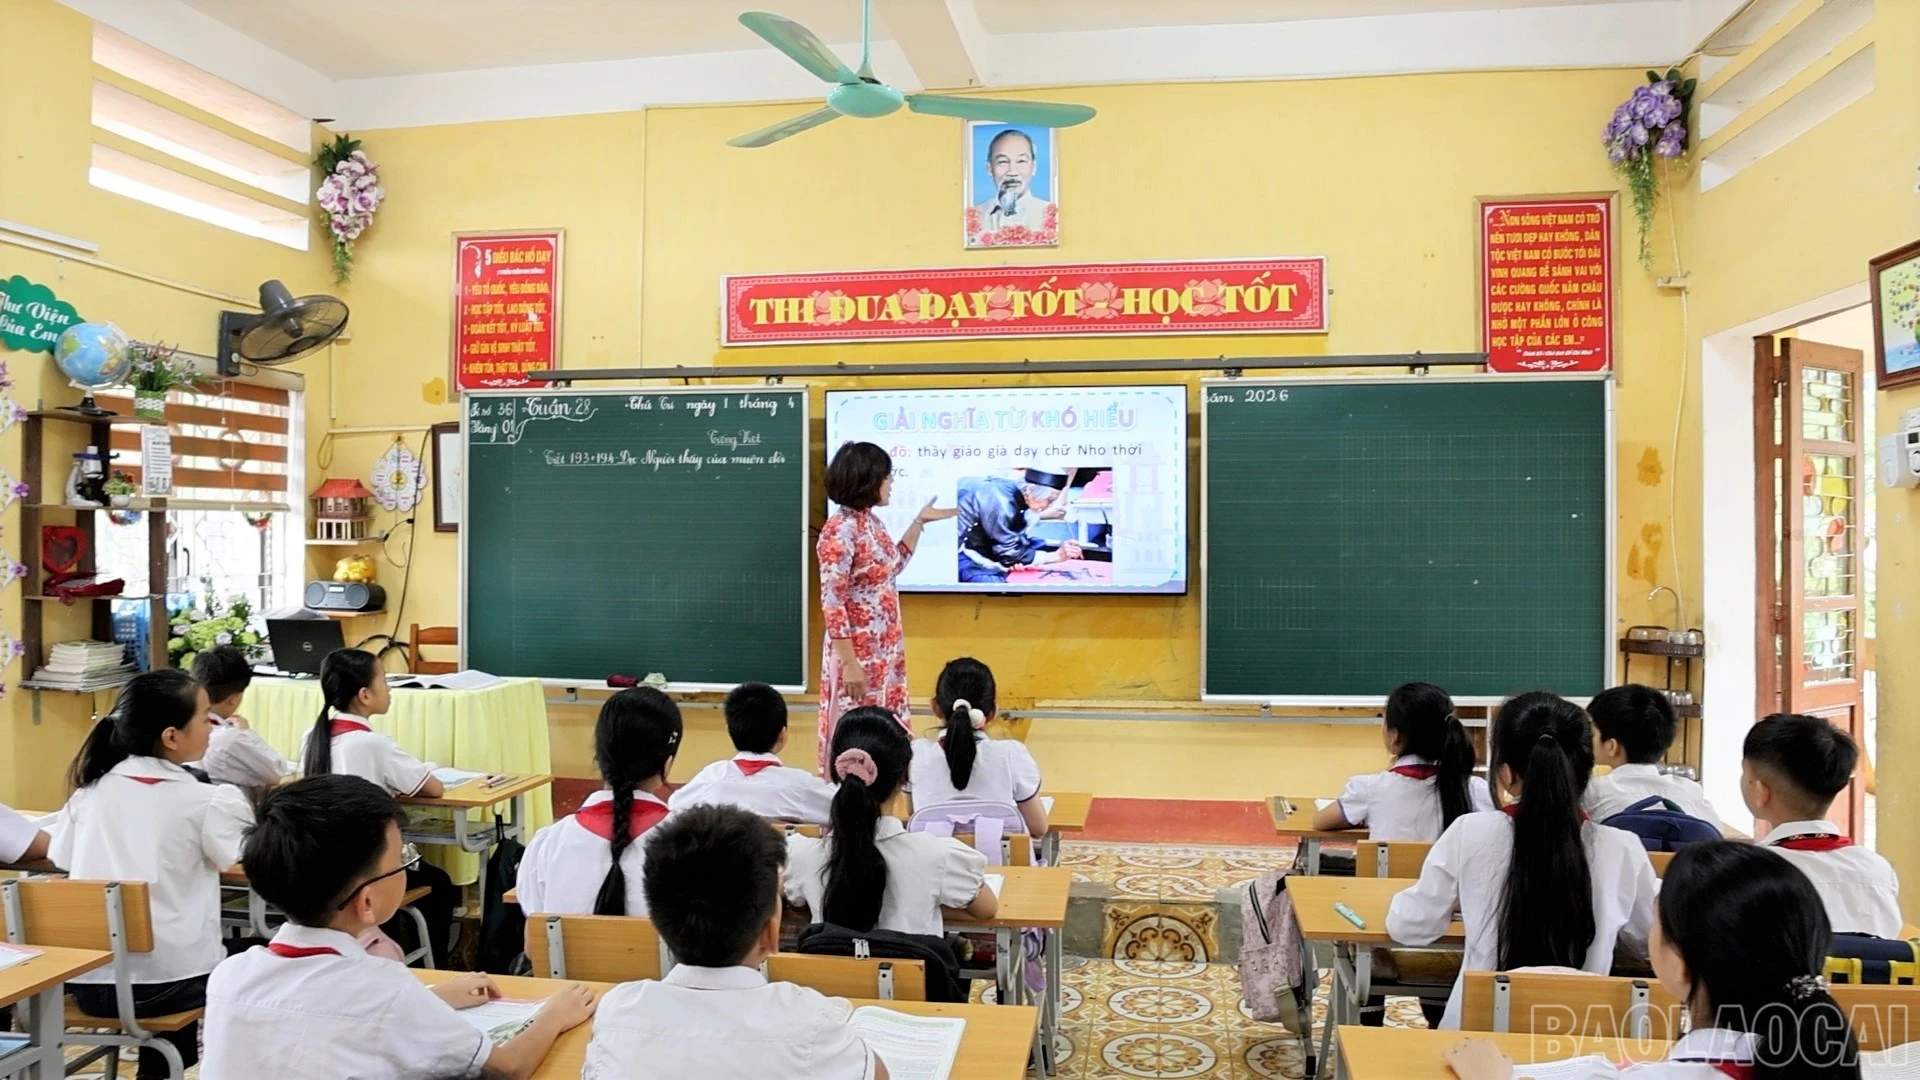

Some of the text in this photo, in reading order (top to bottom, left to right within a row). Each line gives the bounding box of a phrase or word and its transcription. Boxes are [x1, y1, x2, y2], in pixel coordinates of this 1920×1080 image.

[1542, 212, 1557, 228] VIỆT
[1558, 213, 1574, 225] NAM
[1575, 211, 1586, 225] CÓ
[1539, 231, 1554, 242] HAY
[484, 248, 492, 266] 5
[509, 246, 525, 264] BÁC
[1506, 247, 1522, 263] VIỆT
[1523, 249, 1540, 260] NAM
[1542, 246, 1552, 260] CÓ
[1491, 267, 1508, 278] VINH
[1510, 266, 1537, 278] QUANG
[1574, 265, 1588, 276] VAI
[1491, 282, 1507, 296] CÁC
[750, 297, 815, 325] THI
[918, 290, 989, 328] DẠY
[1008, 275, 1084, 318] TỐT
[1119, 287, 1206, 325] HỌC
[1218, 270, 1298, 313] TỐT
[1515, 302, 1532, 312] HAY
[1592, 297, 1603, 310] LÀ
[26, 301, 70, 325] Viện
[29, 322, 59, 342] Em
[1544, 332, 1561, 345] CÁC
[1244, 389, 1289, 403] 2026
[497, 402, 513, 416] 36
[575, 398, 591, 415] 28
[686, 399, 716, 418] ngày
[723, 397, 728, 409] 1
[739, 394, 777, 417] tháng
[788, 396, 795, 409] 4
[873, 401, 1135, 430] GIẢI NGHĨA TỪ KHÓ HIỂU
[918, 445, 947, 461] thầy
[953, 444, 982, 460] giáo
[988, 444, 1007, 460] già
[1045, 443, 1071, 456] chữ
[1078, 444, 1106, 456] Nho
[1113, 442, 1142, 456] thời
